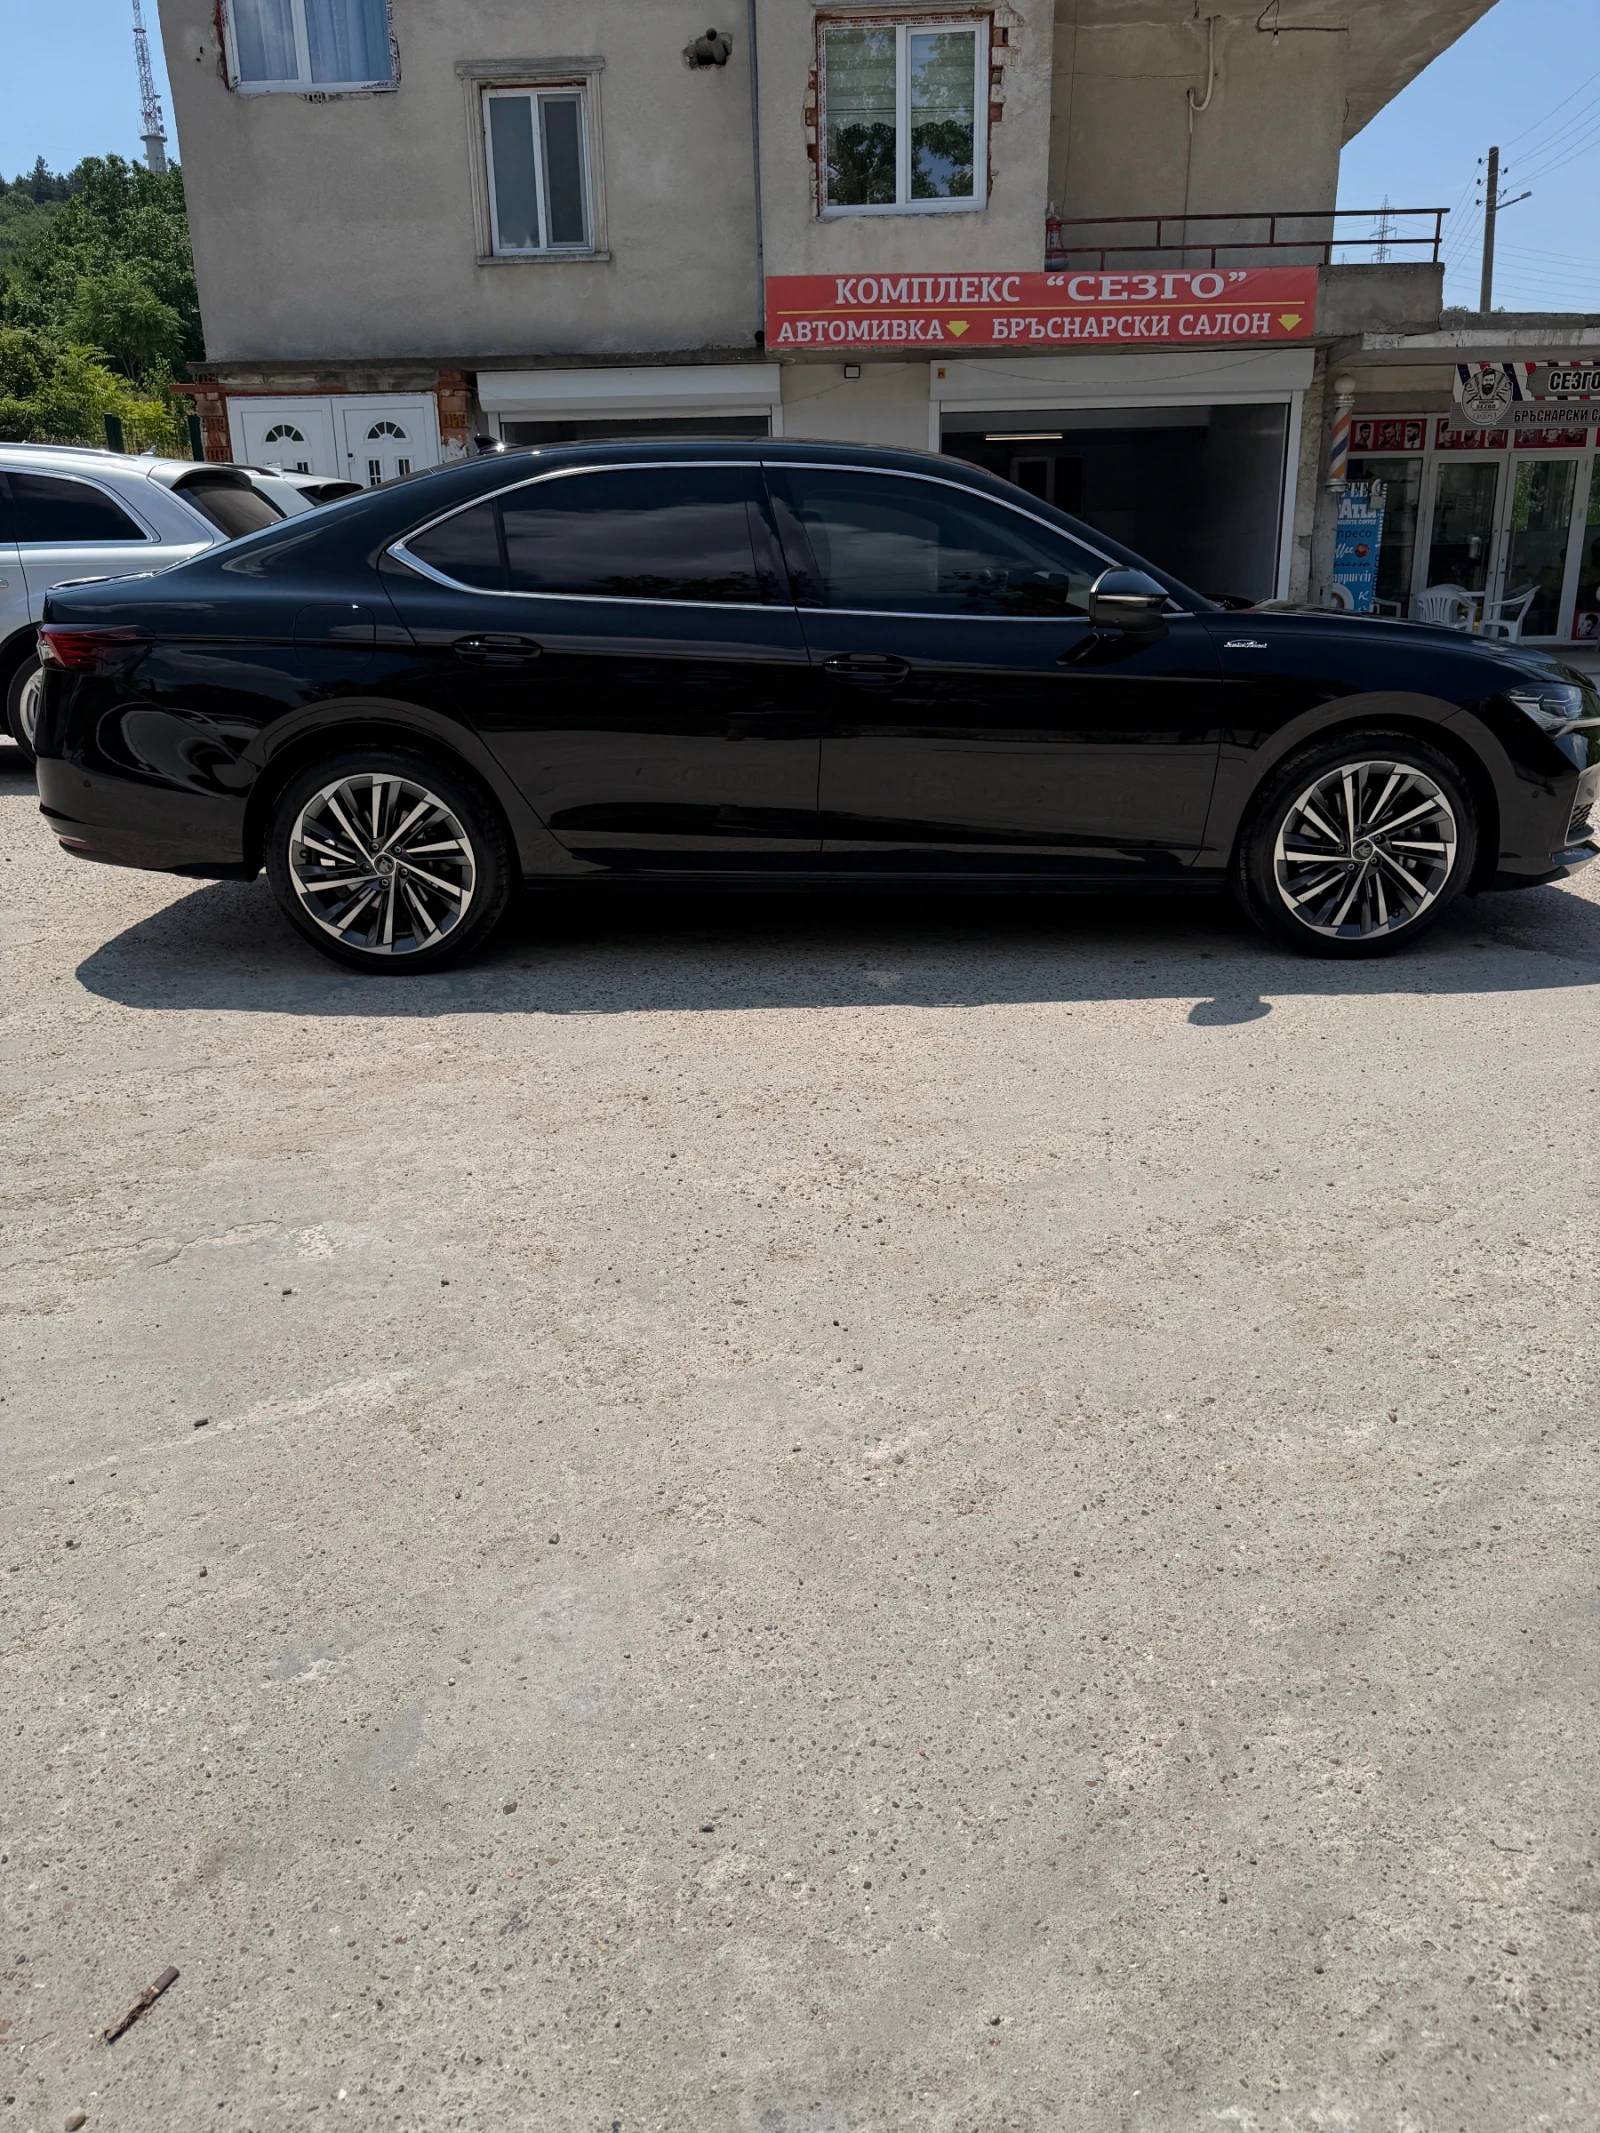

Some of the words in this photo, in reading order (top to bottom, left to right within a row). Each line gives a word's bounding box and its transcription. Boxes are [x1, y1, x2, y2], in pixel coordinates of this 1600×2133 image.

[835, 276, 1020, 305] КОМПЛЕКС
[777, 318, 945, 343] АВТОМИВКА
[991, 315, 1170, 339] БРЪСНАРСКИ
[1177, 313, 1271, 337] САЛОН
[1514, 408, 1588, 422] БРЪСНАРСКИ
